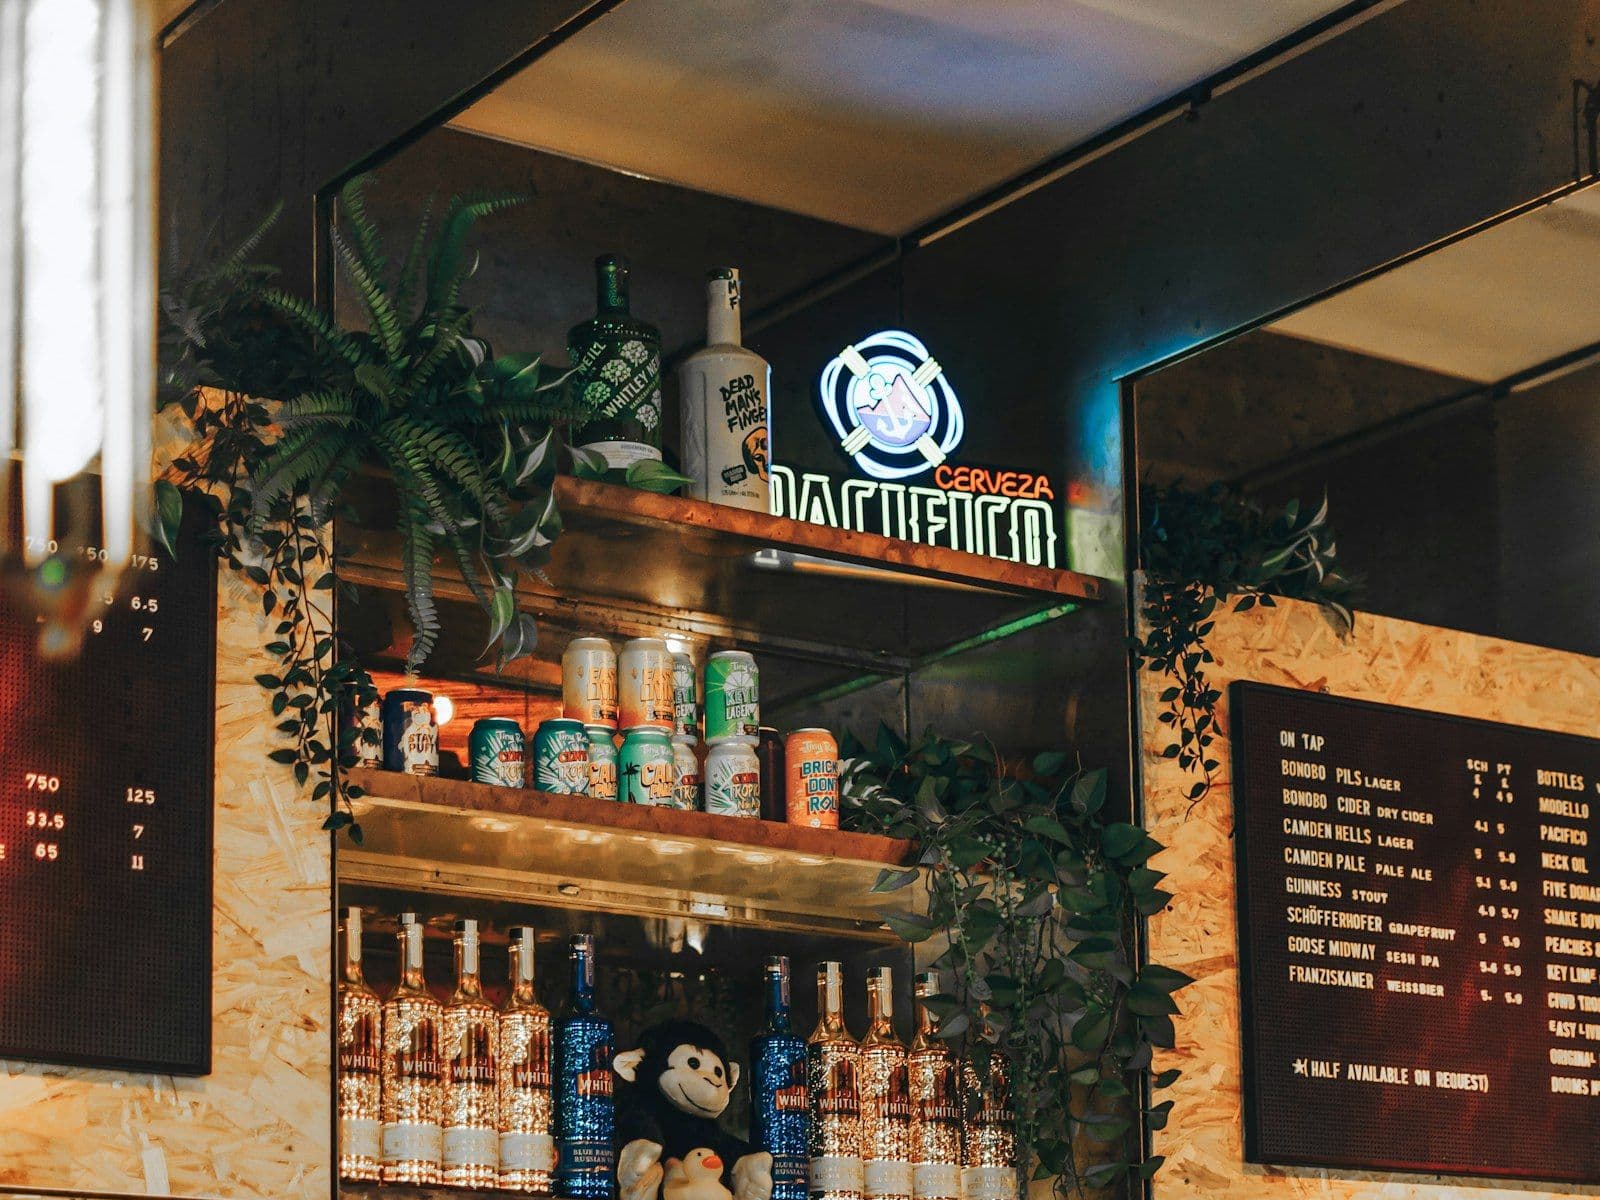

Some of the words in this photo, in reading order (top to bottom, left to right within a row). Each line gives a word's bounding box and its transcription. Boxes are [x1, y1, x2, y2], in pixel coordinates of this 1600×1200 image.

[602, 370, 649, 418] WHITLEY
[719, 374, 754, 401] DEAD
[725, 388, 761, 416] MAN'S
[727, 407, 767, 433] FINGE
[935, 466, 1054, 500] CERVEZA
[131, 554, 159, 571] 175
[131, 596, 158, 613] 6.5
[93, 620, 103, 634] 9
[142, 627, 153, 642] 7
[1279, 730, 1295, 748] ON
[1302, 733, 1325, 751] TAP
[1281, 759, 1327, 781] BONOBO
[1335, 767, 1362, 786] PILS
[1364, 776, 1401, 792] LAGER
[1496, 763, 1512, 775] PT
[1536, 769, 1585, 791] BOTTLES
[25, 773, 60, 792] 750
[126, 788, 155, 805] 125
[1282, 788, 1328, 810] BONOBO
[1337, 796, 1371, 816] CIDER
[1377, 806, 1399, 820] DRY
[1401, 809, 1434, 825] CIDER
[1538, 796, 1589, 819] MODELLO
[26, 811, 65, 830] 33.5
[132, 824, 144, 839] 7
[1283, 818, 1332, 840] CAMDEN
[1334, 824, 1372, 845] HELLS
[1377, 834, 1414, 851] LAGER
[1540, 824, 1588, 846] PACIFICO
[35, 843, 58, 860] 65
[131, 855, 144, 870] 11
[1284, 847, 1333, 868] CAMDEN
[1336, 853, 1366, 873] PALE
[1375, 863, 1404, 878] PALE
[1411, 868, 1433, 882] ALE
[1541, 851, 1569, 871] NECK
[1571, 856, 1589, 874] OIL
[1285, 876, 1342, 899] GUINNESS
[1352, 889, 1388, 904] STOUT
[1543, 879, 1568, 899] FIVE
[1286, 905, 1383, 933] SCHÖFFERHOFER
[1388, 921, 1456, 941] GRAPEFRUIT
[1544, 908, 1578, 928] SNAKE
[1287, 936, 1325, 955] GOOSE
[1329, 940, 1376, 961] MIDWAY
[1386, 951, 1415, 966] SESH
[1421, 955, 1440, 968] IPA
[1545, 935, 1593, 957] PEACHES
[1289, 965, 1374, 990] FRANZISKANER
[1386, 979, 1445, 997] WEISSBIER
[1546, 963, 1568, 981] KEY
[1548, 1020, 1577, 1038] EASY
[1347, 1063, 1409, 1085] AVAILABLE
[1414, 1069, 1431, 1087] ON
[1436, 1071, 1489, 1093] REQUEST)
